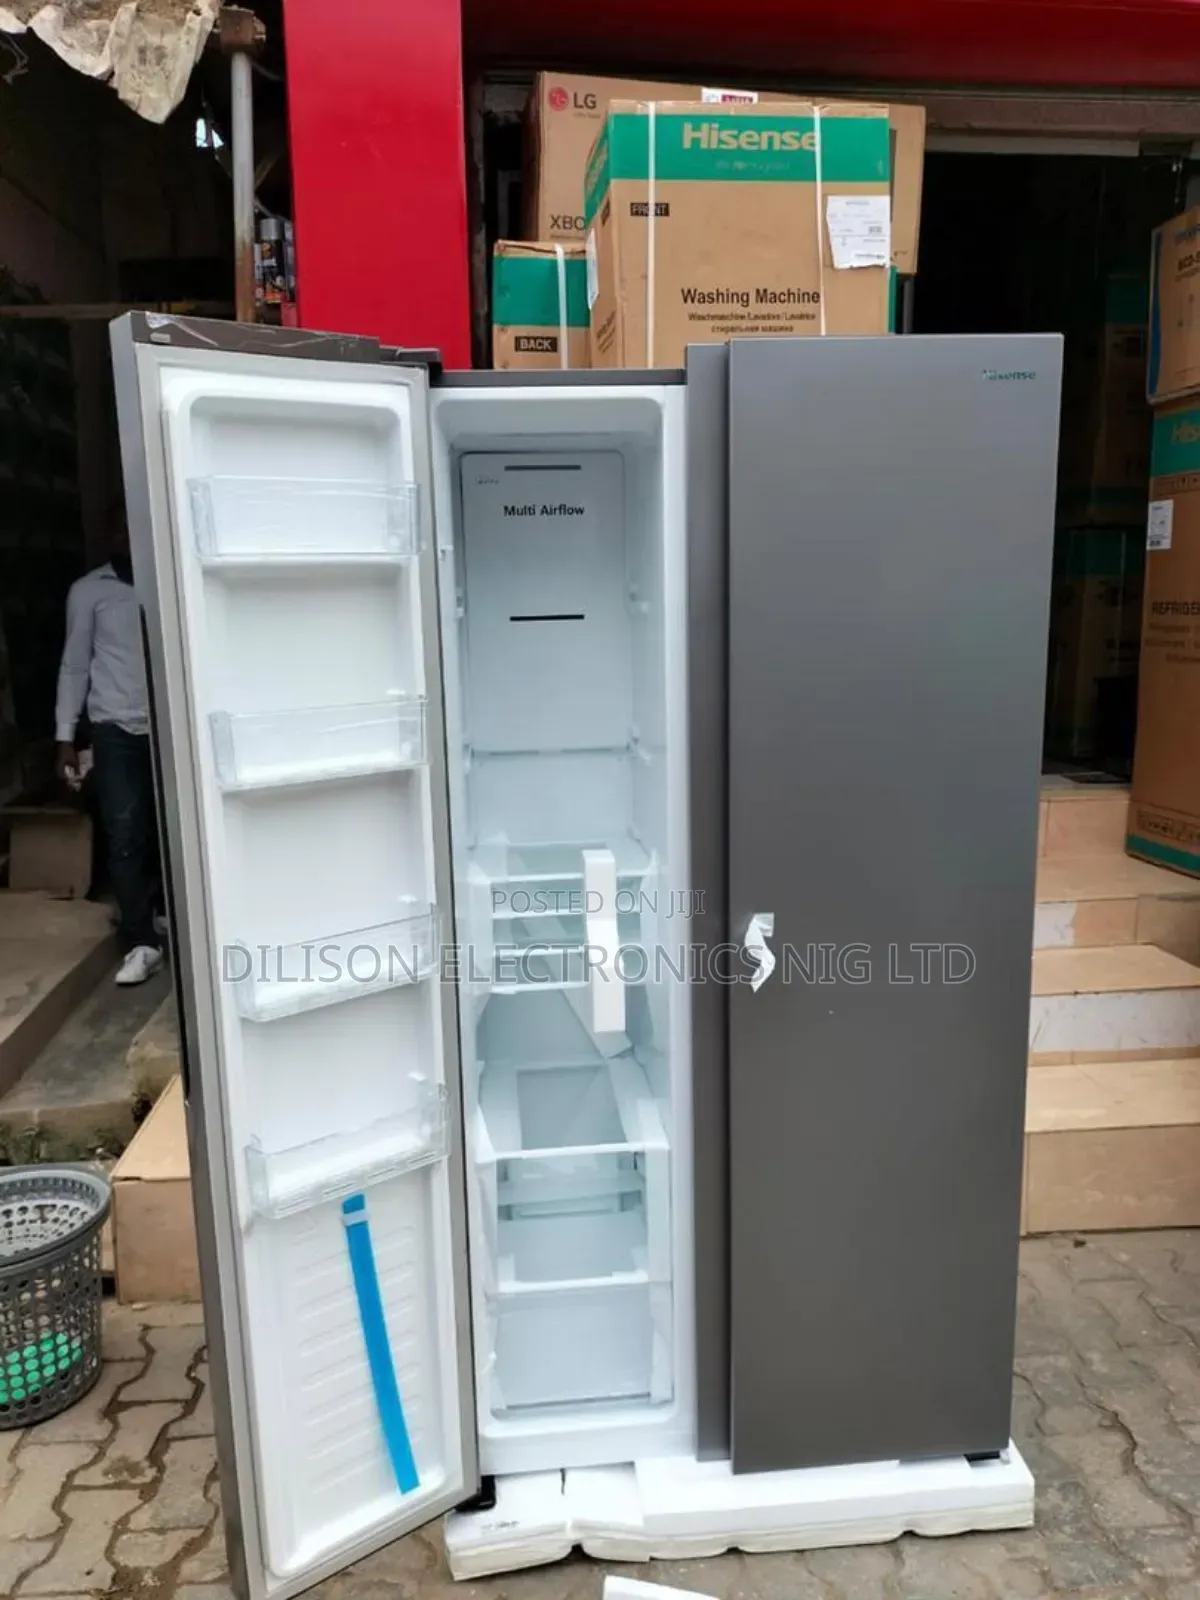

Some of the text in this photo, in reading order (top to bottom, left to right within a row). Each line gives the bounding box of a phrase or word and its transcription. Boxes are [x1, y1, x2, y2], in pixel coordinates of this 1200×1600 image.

[573, 91, 597, 110] LG
[683, 122, 817, 151] Hisense
[681, 287, 820, 307] Washing Machine
[519, 338, 552, 350] BACK
[503, 503, 585, 517] Multi Airflow
